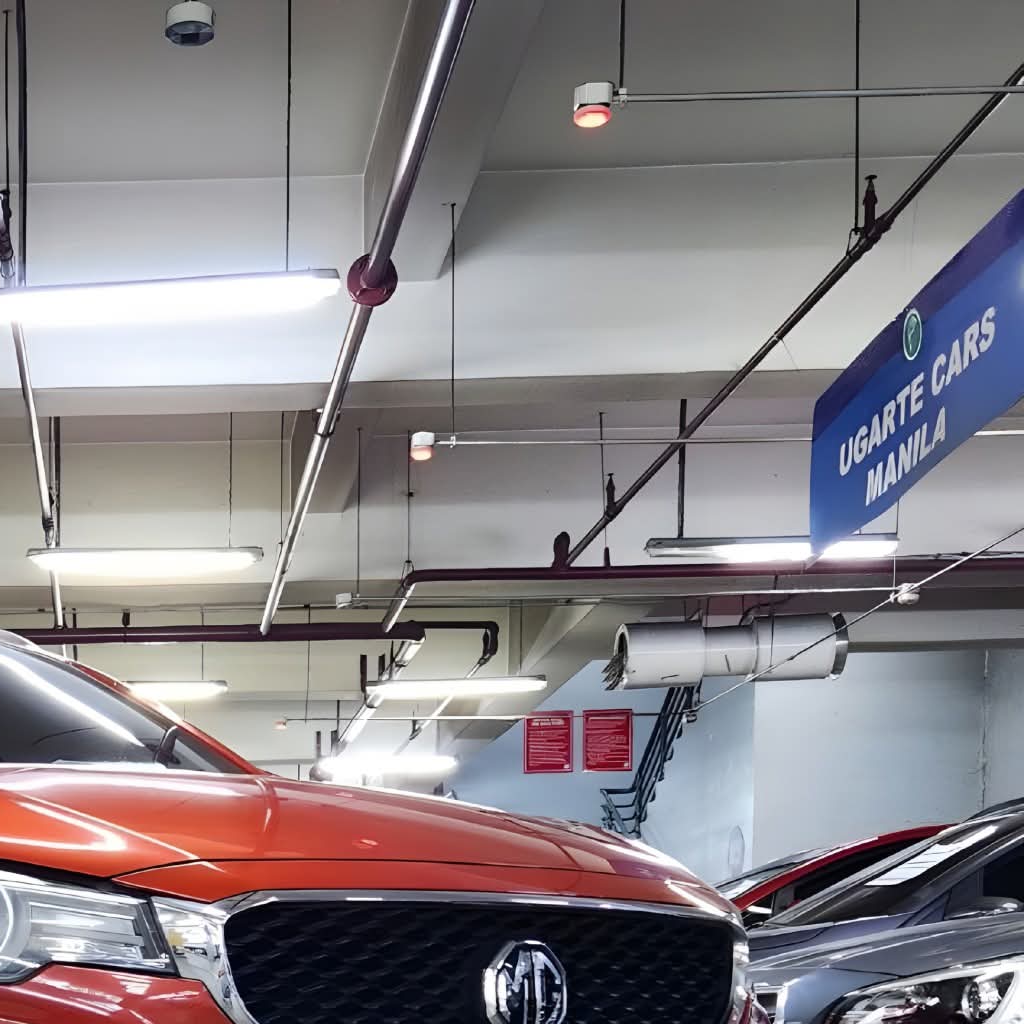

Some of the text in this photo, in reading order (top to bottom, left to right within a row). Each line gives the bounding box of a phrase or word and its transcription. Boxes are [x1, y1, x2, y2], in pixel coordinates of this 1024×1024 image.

[839, 306, 997, 477] UGARTE CARS
[865, 406, 946, 506] MANILA
